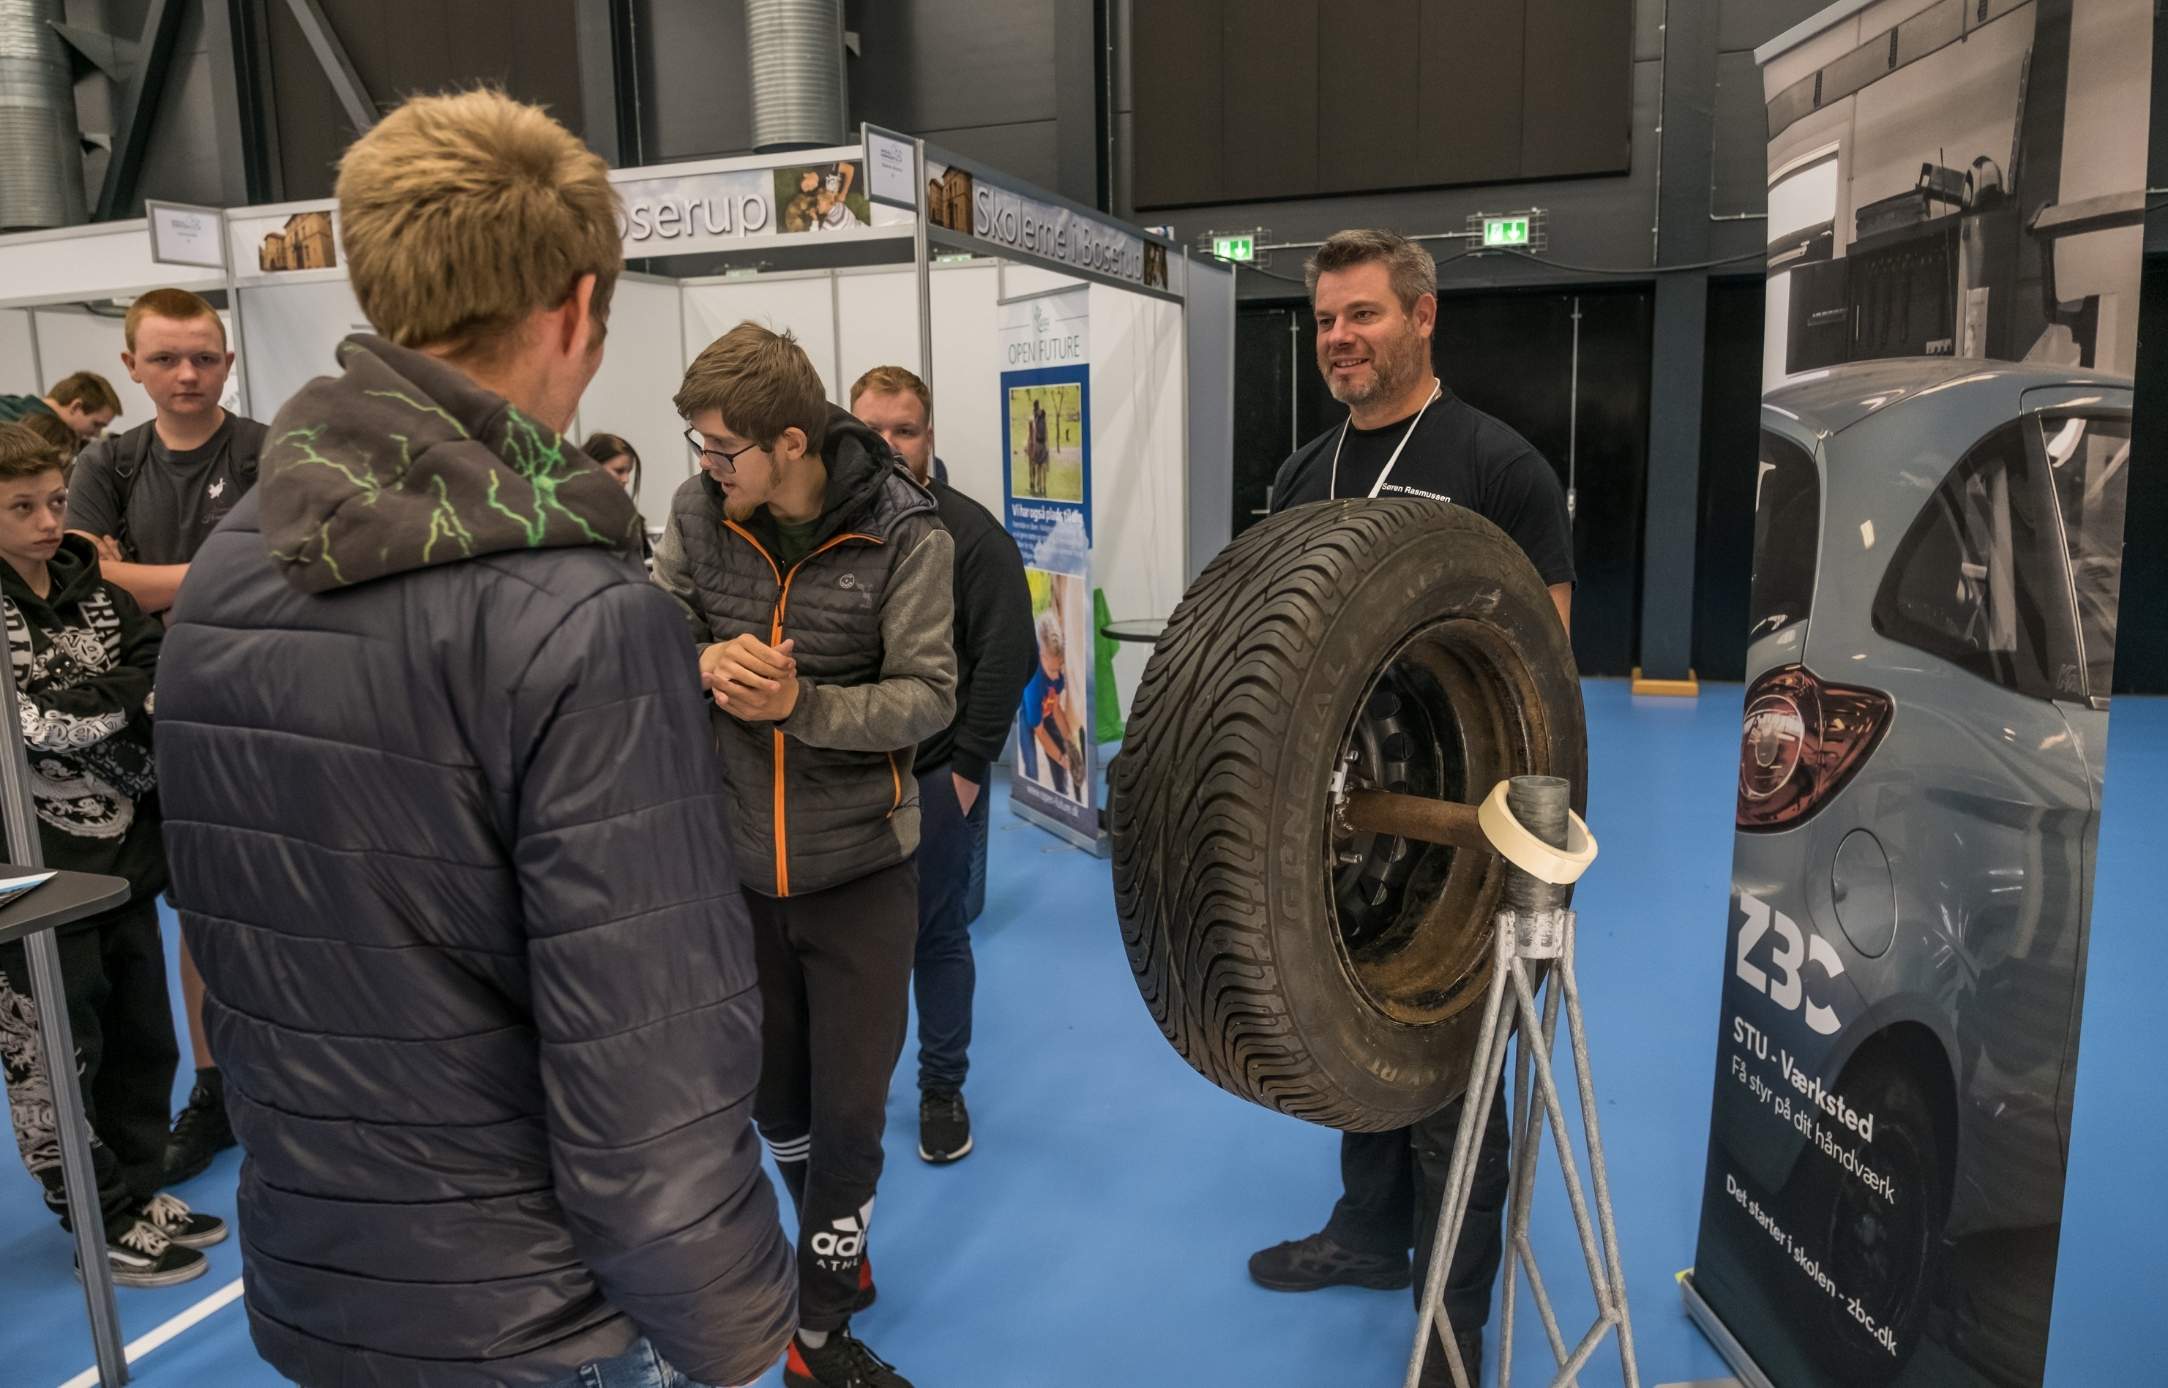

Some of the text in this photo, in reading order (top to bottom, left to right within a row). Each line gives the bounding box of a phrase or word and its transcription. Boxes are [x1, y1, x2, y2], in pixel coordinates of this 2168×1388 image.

[976, 186, 1143, 280] Skolerne i Boserup
[1008, 335, 1080, 365] OPEN FUTURE
[1381, 482, 1451, 503] Søren Rasmussen
[1736, 892, 1845, 1035] ZBC
[1732, 1055, 1895, 1205] Få styr på dit håndværk
[1734, 1016, 1767, 1060] STU
[1781, 1049, 1873, 1143] Værksted
[1726, 1173, 1747, 1208] Det
[1749, 1201, 1785, 1246] starter
[1794, 1247, 1836, 1297] skolen
[1847, 1297, 1897, 1357] zbc.dk
